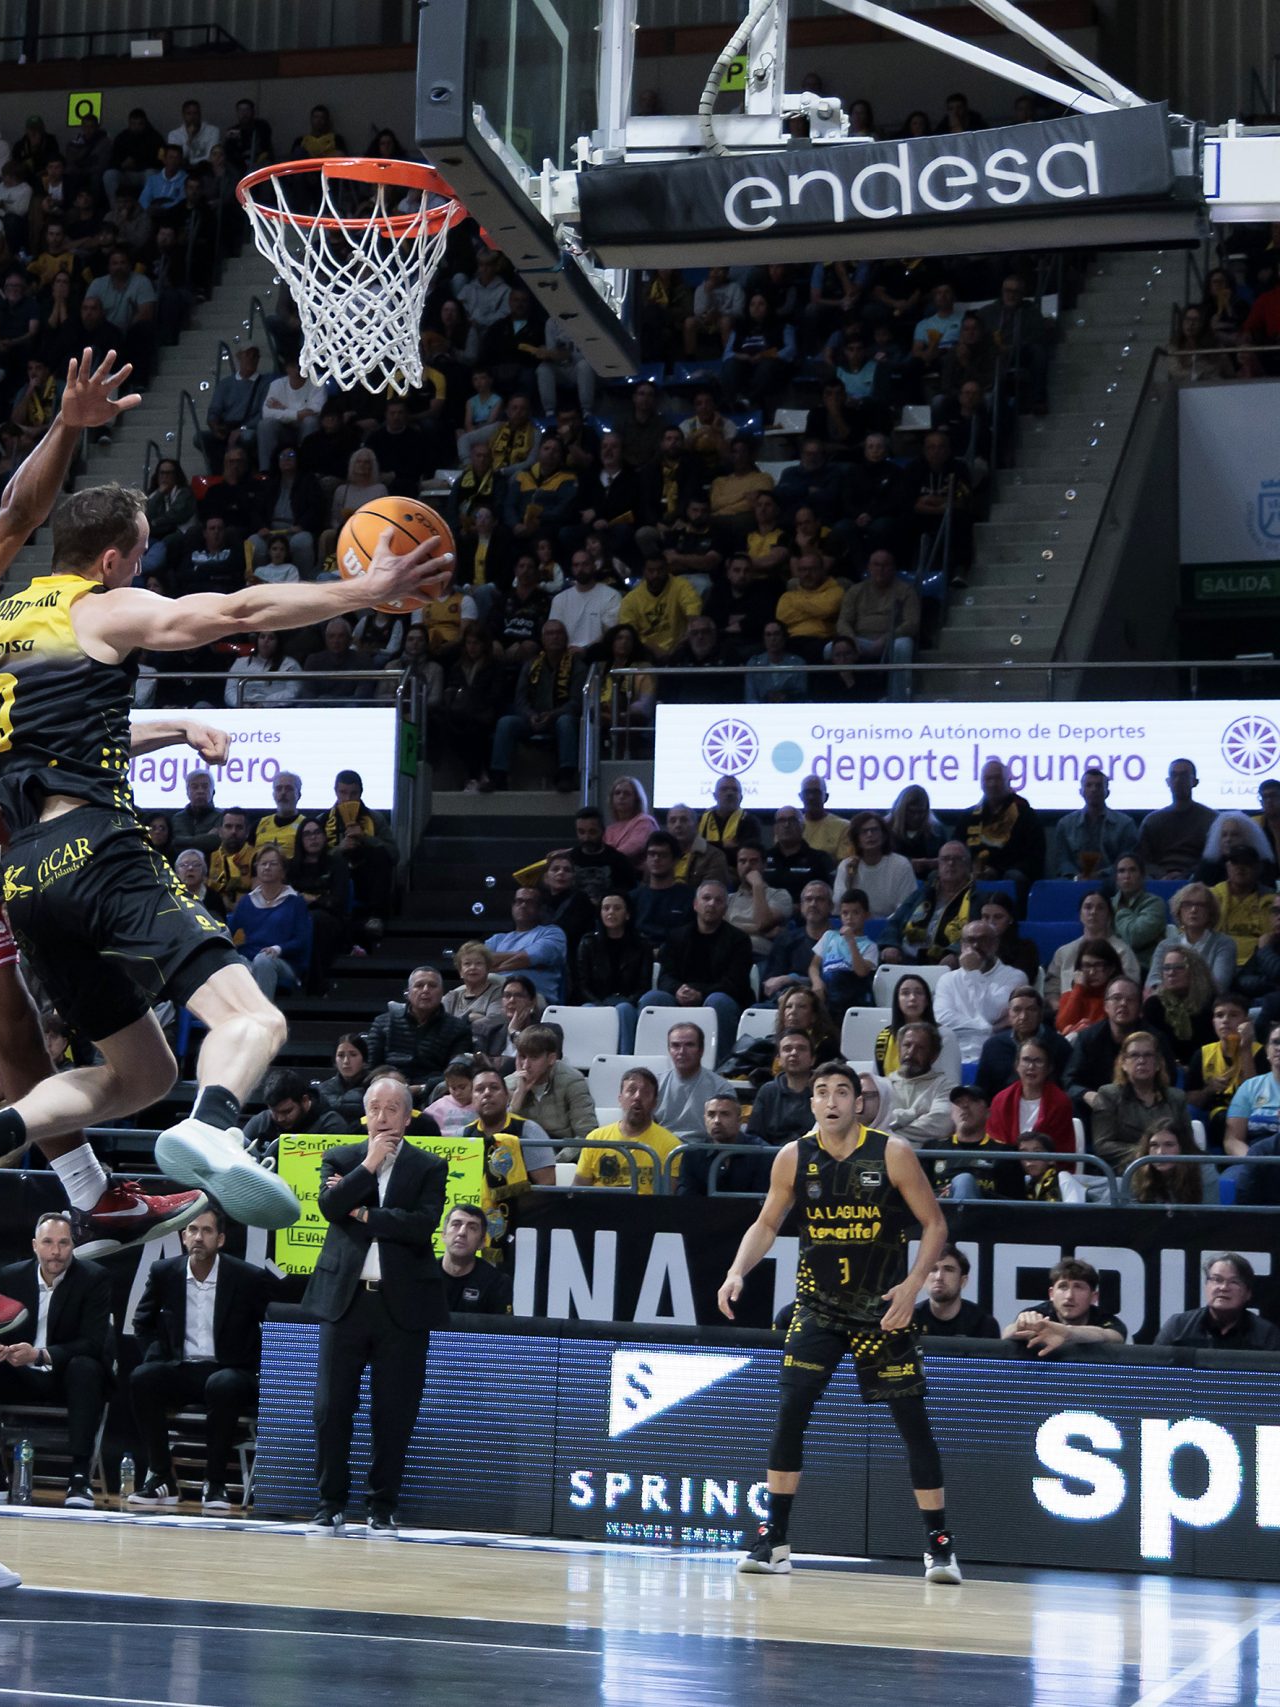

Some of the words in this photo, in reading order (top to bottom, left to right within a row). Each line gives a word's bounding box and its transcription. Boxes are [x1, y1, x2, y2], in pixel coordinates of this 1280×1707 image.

[727, 62, 743, 80] P
[723, 140, 1101, 232] endesa
[811, 723, 914, 744] Organismo
[919, 723, 1022, 740] Autónomo
[1028, 723, 1051, 739] de
[1058, 723, 1146, 743] Deportes
[811, 744, 959, 791] deporte
[973, 743, 1146, 793] lgunero
[807, 1206, 825, 1220] LA
[826, 1205, 882, 1220] LAGUNA
[837, 1257, 851, 1286] 3
